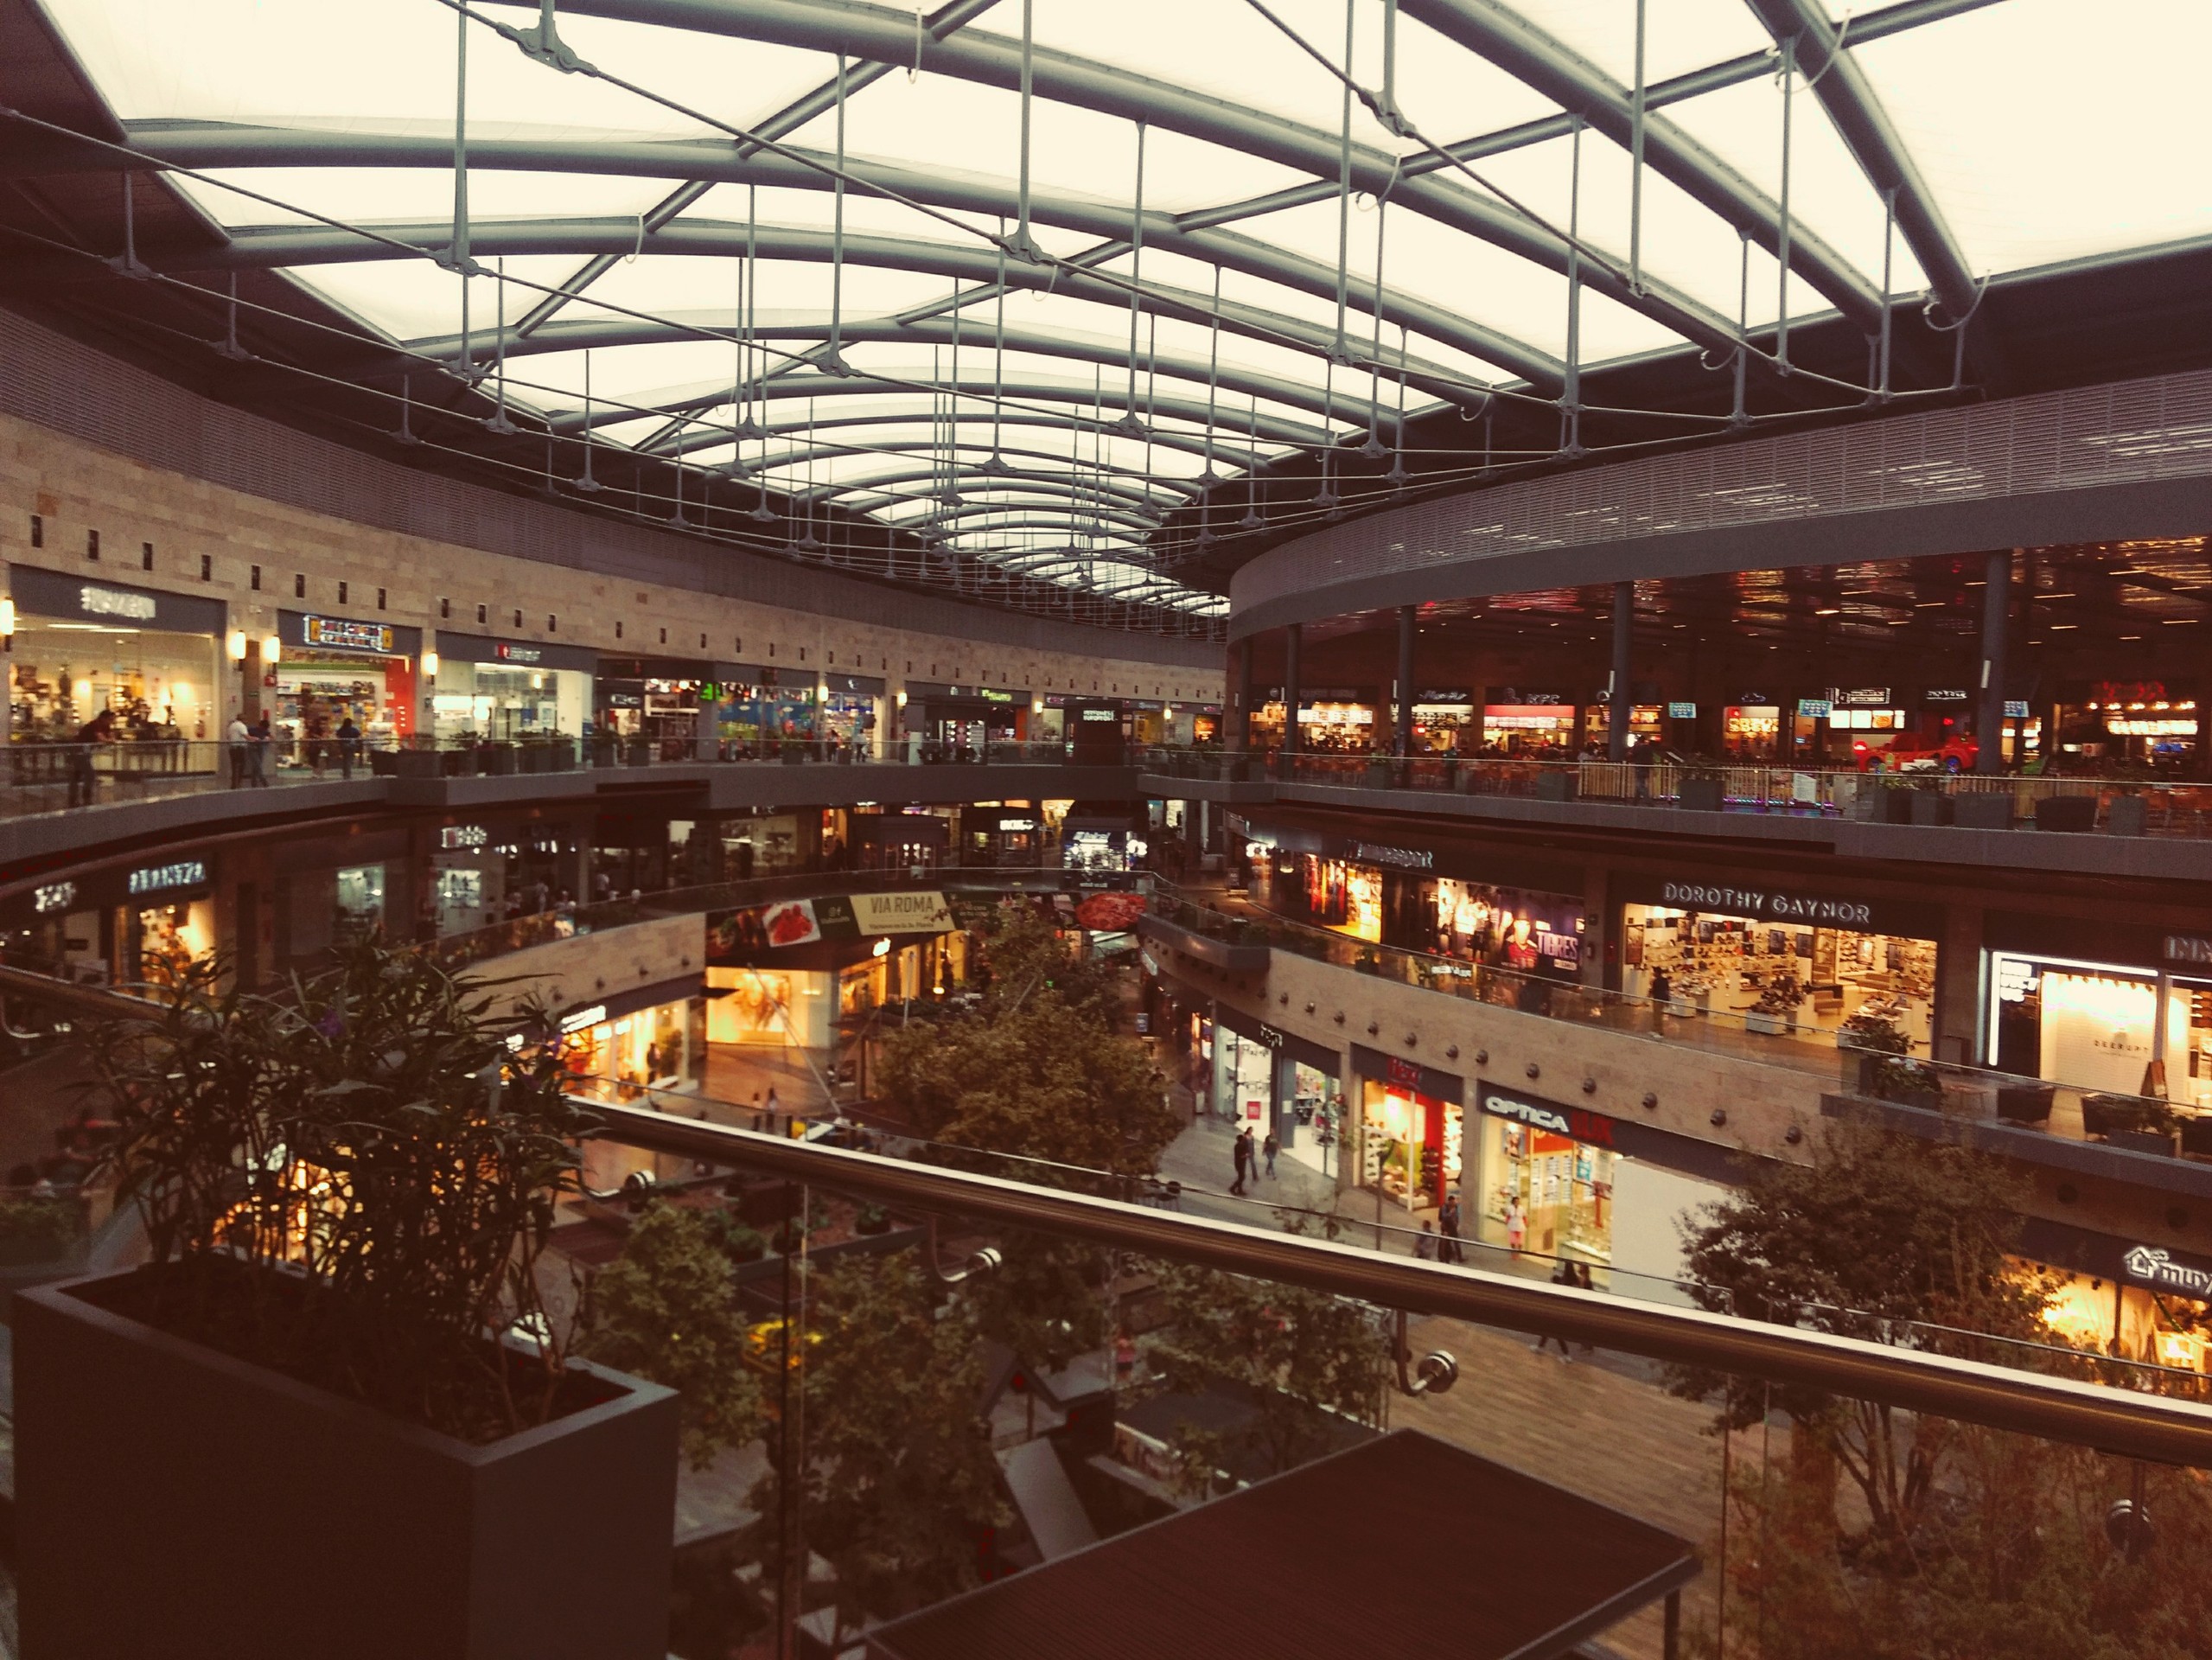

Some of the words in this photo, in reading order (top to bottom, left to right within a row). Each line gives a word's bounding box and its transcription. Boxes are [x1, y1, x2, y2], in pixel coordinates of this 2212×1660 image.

[1527, 693, 1560, 705] KFC
[870, 897, 891, 914] VIA
[896, 896, 934, 913] ROMA
[1664, 884, 1764, 910] DOROTHY
[1772, 894, 1870, 923] GAYNOR
[1537, 930, 1578, 960] TIGRES
[1486, 1096, 1569, 1133] OPTICA
[1571, 1110, 1614, 1146] LUX
